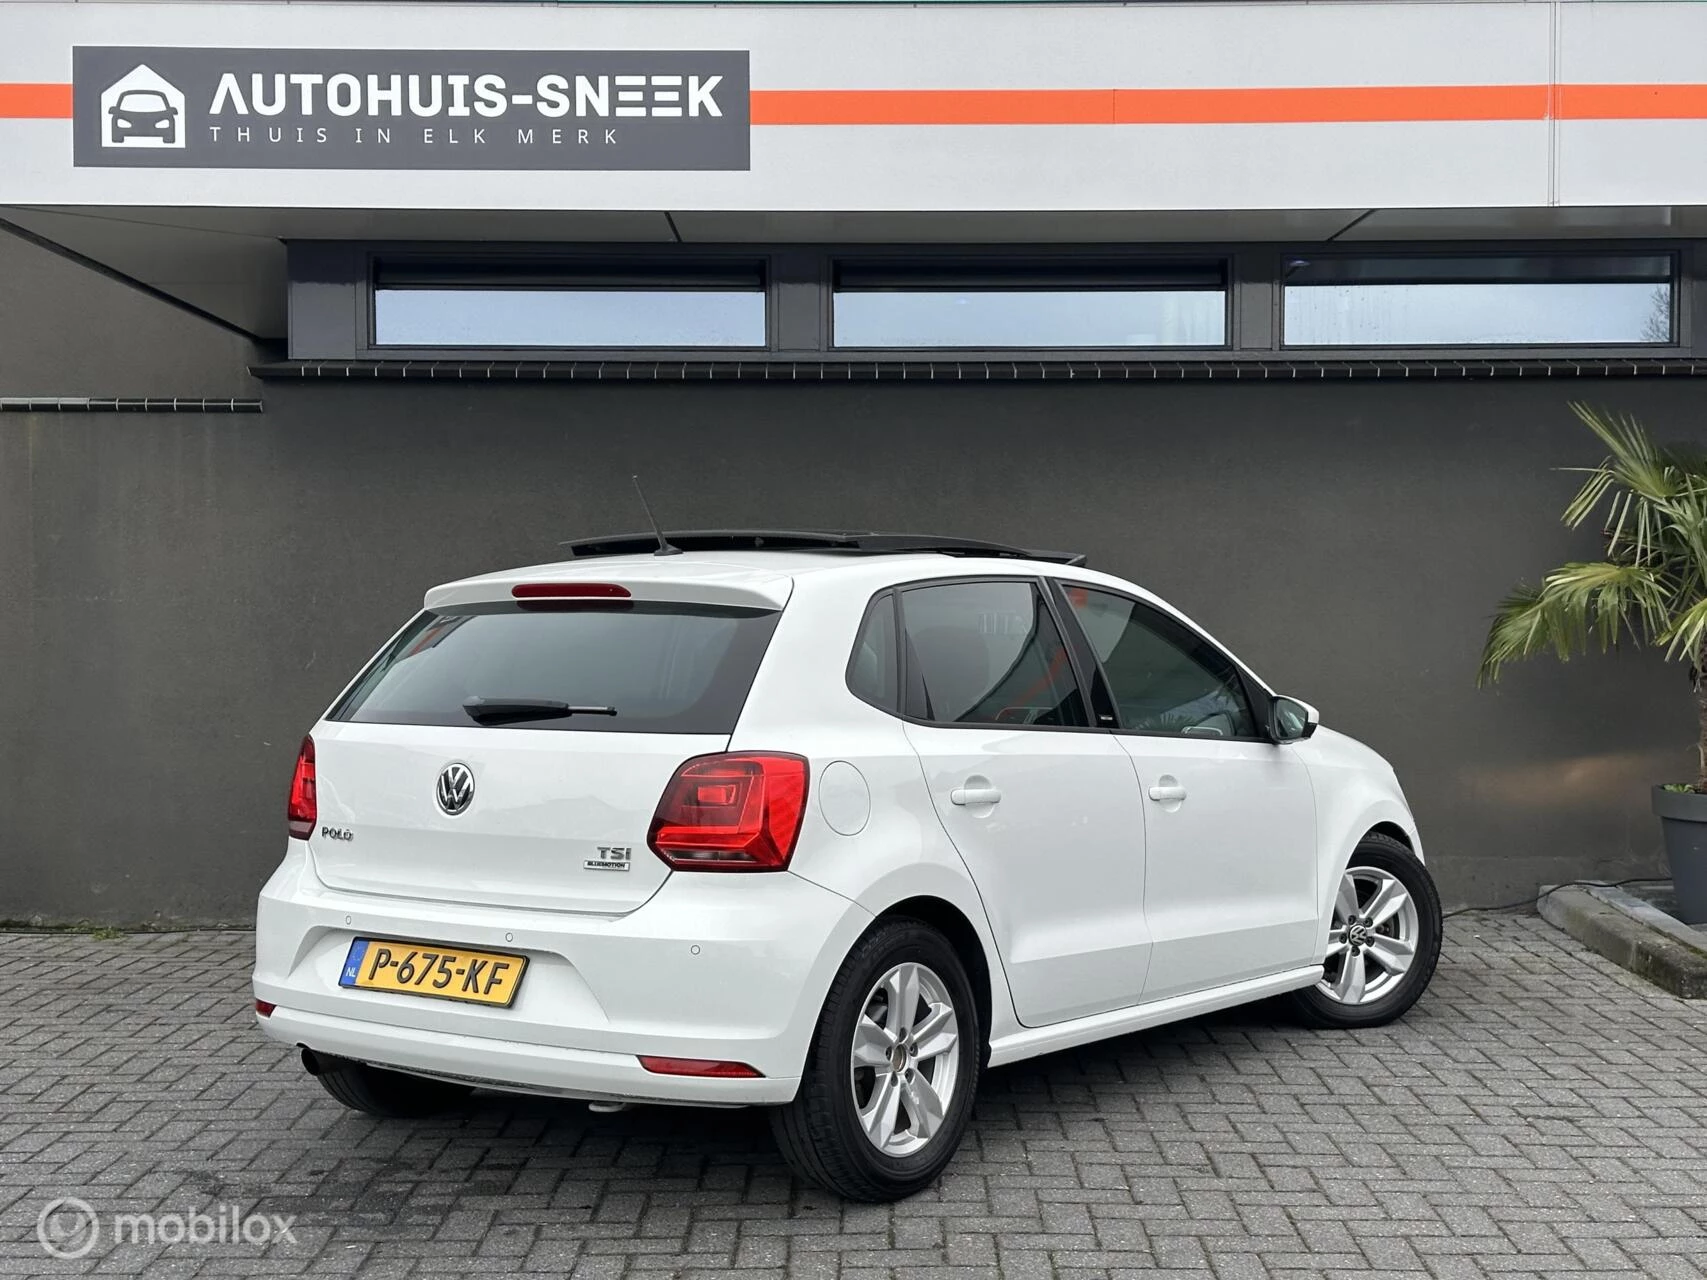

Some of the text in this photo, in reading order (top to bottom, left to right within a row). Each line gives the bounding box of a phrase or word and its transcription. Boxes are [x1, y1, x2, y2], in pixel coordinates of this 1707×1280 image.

[208, 72, 723, 118] AUTOHUIS-SNEEK
[209, 126, 617, 145] THUIS IN ELK MERK
[321, 826, 354, 841] POLO
[596, 846, 632, 860] TSI
[345, 966, 356, 978] NL
[367, 947, 510, 995] P-675-KF
